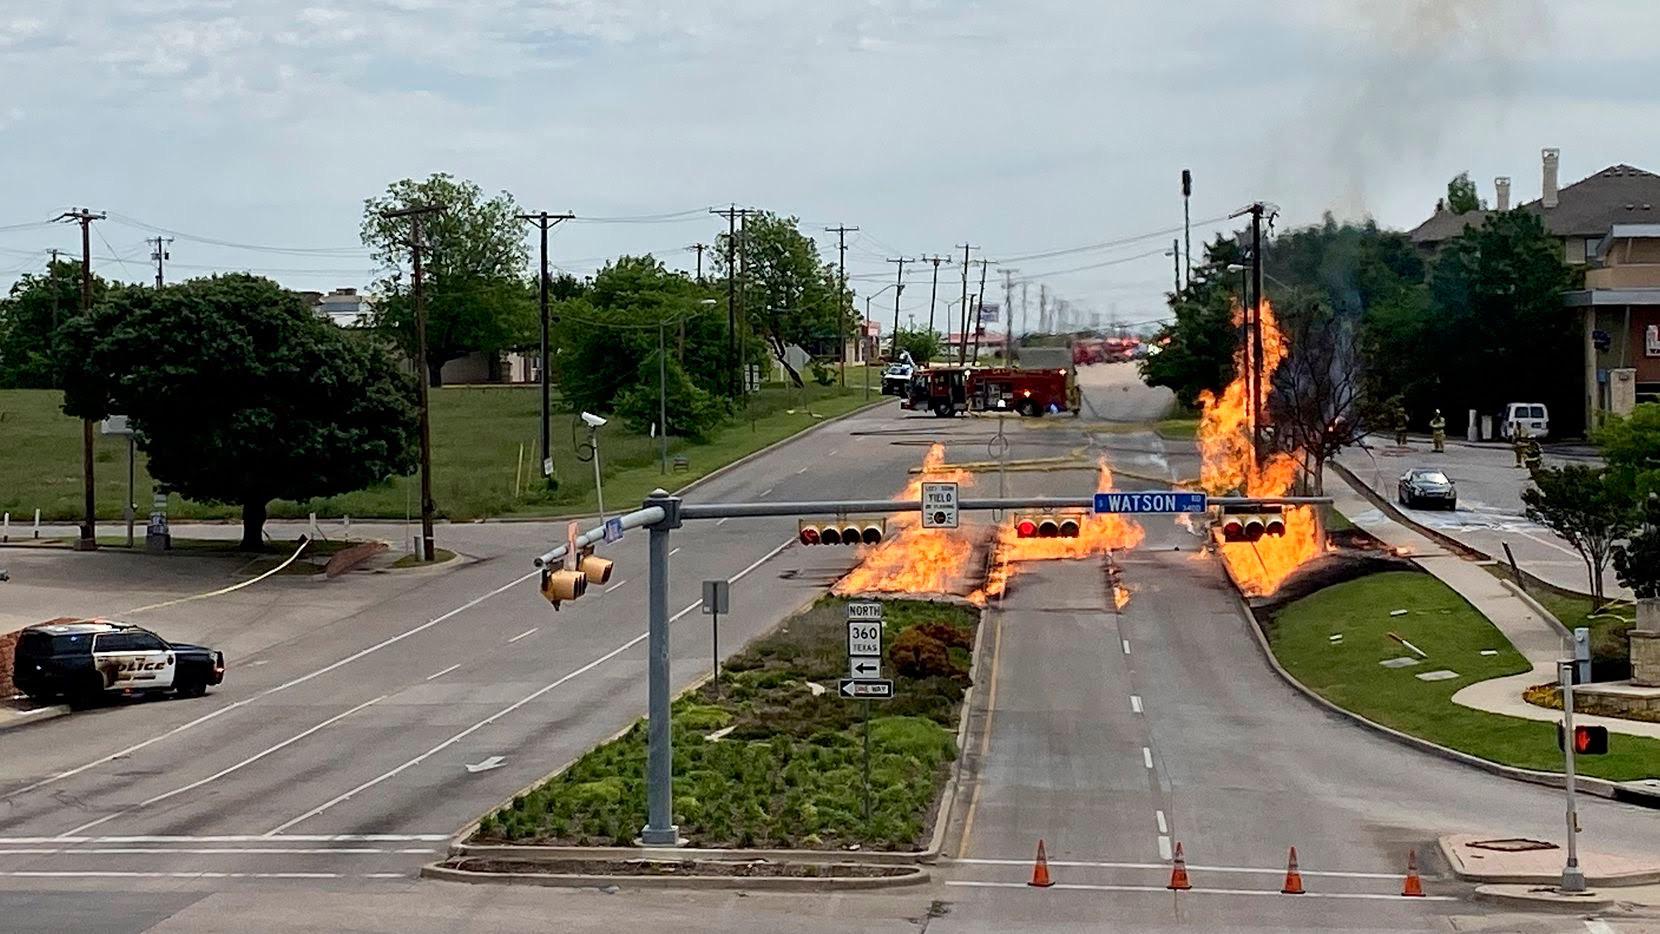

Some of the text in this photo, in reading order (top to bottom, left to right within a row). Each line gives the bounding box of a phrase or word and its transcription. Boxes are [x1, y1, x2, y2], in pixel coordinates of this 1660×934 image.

[928, 493, 952, 503] YIELD
[1108, 495, 1176, 512] WATSON
[849, 606, 880, 616] NORTH
[852, 627, 878, 640] 360
[853, 643, 878, 652] TEXAS
[109, 661, 166, 672] OLICE
